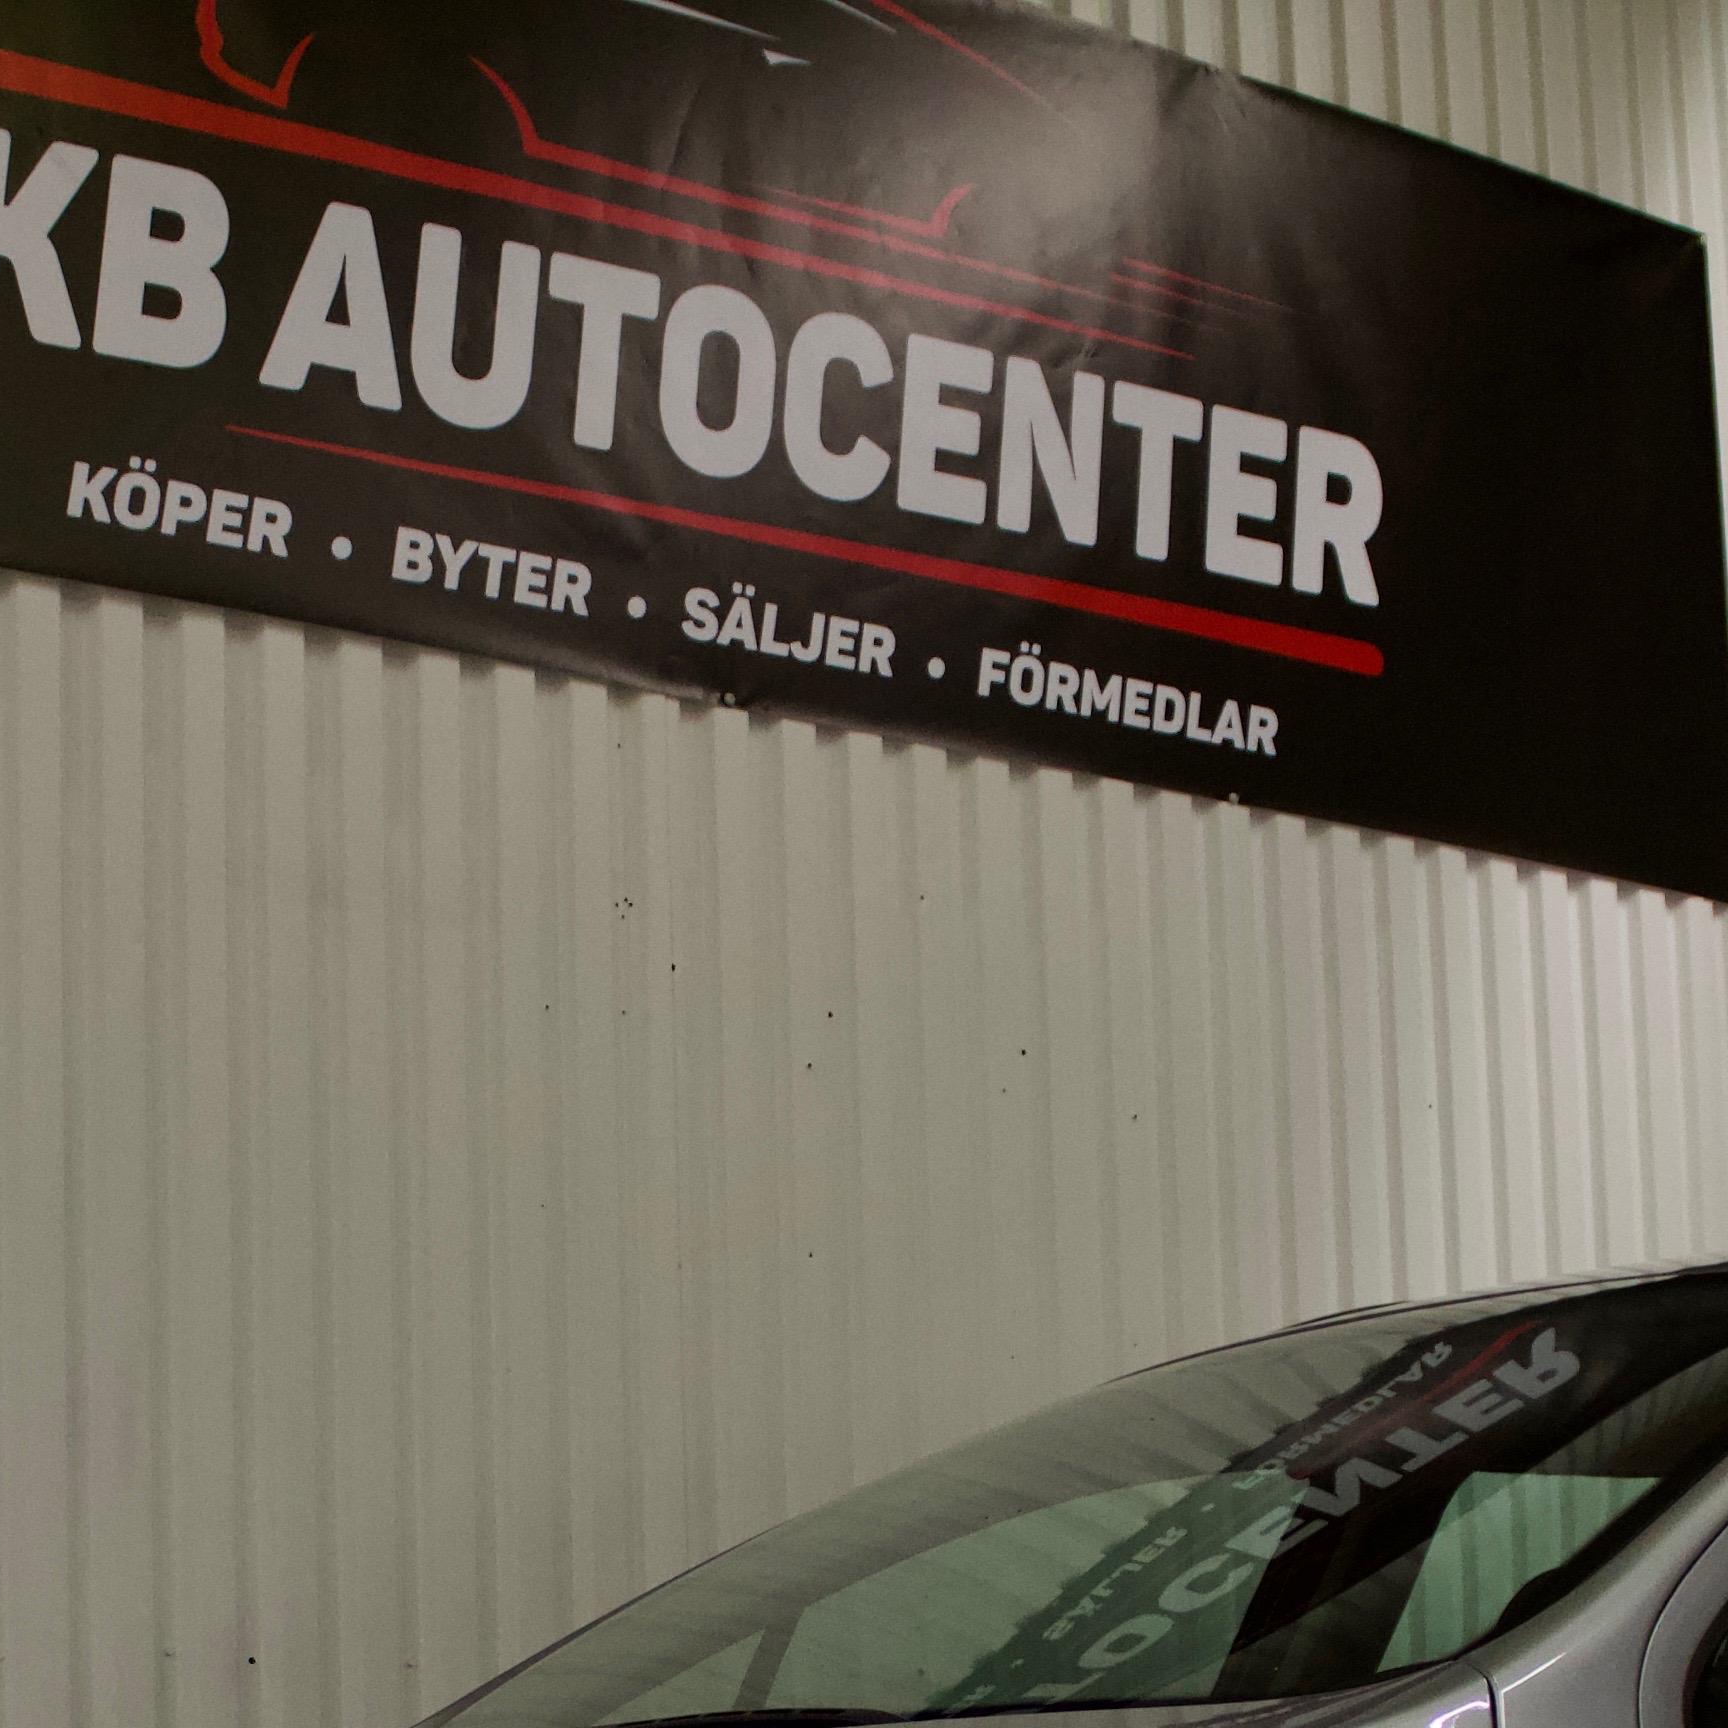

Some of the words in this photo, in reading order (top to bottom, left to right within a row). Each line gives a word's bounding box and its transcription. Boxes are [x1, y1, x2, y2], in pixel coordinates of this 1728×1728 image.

[259, 201, 1383, 607] AUTOCENTER
[66, 456, 292, 558] KÖPER
[391, 526, 592, 616] BYTER
[681, 582, 896, 678] SÄLJER
[977, 640, 1279, 756] FÖRMEDLAR
